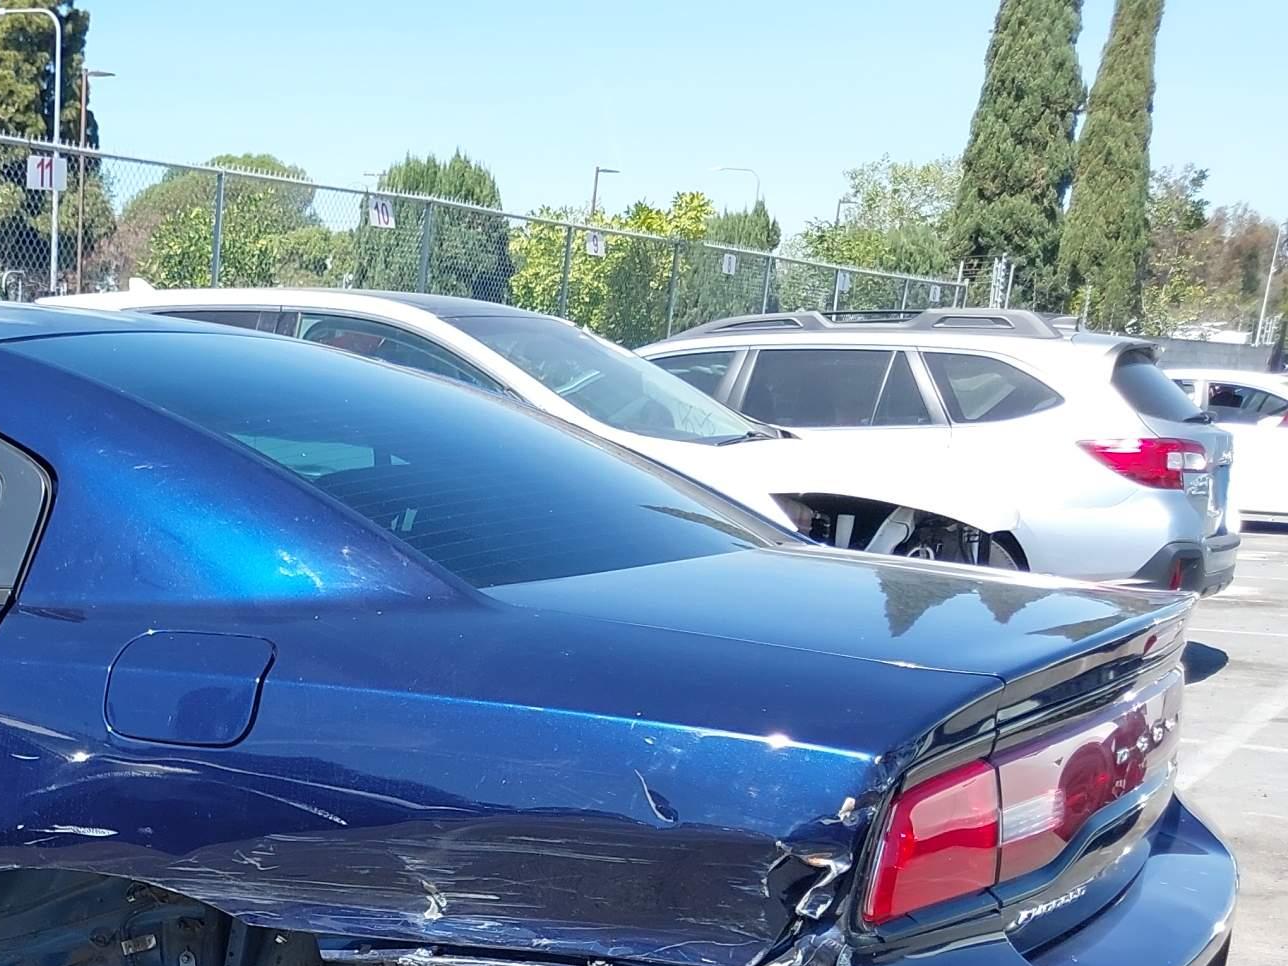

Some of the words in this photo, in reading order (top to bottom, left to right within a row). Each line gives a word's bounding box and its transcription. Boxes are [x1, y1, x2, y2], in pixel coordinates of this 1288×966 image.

[37, 158, 53, 188] 11
[374, 201, 390, 225] 10
[592, 234, 599, 254] 9
